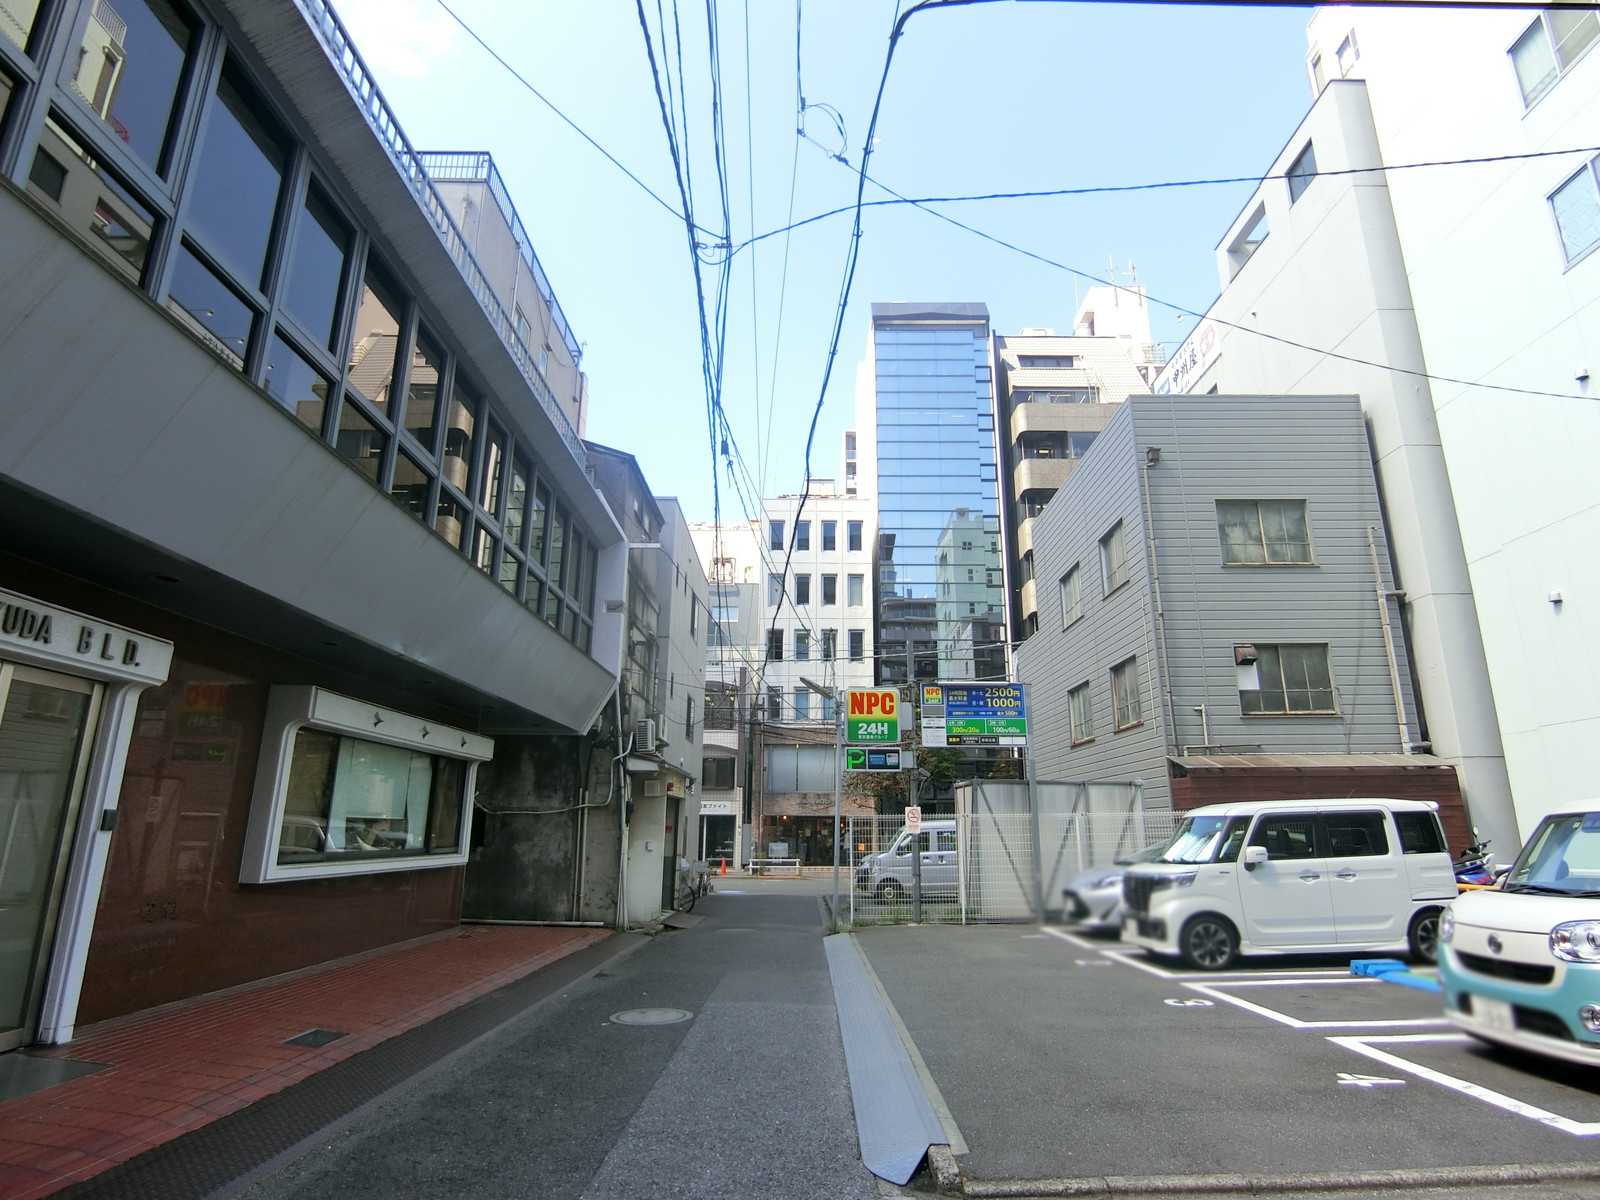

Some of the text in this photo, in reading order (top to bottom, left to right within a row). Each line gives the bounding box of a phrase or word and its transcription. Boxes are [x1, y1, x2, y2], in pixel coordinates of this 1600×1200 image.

[926, 688, 940, 696] NPC
[985, 687, 1021, 698] 2500円
[851, 692, 895, 715] NPC
[986, 698, 1021, 708] 1000円
[858, 723, 888, 735] 24H
[1337, 1072, 1407, 1087] 4
